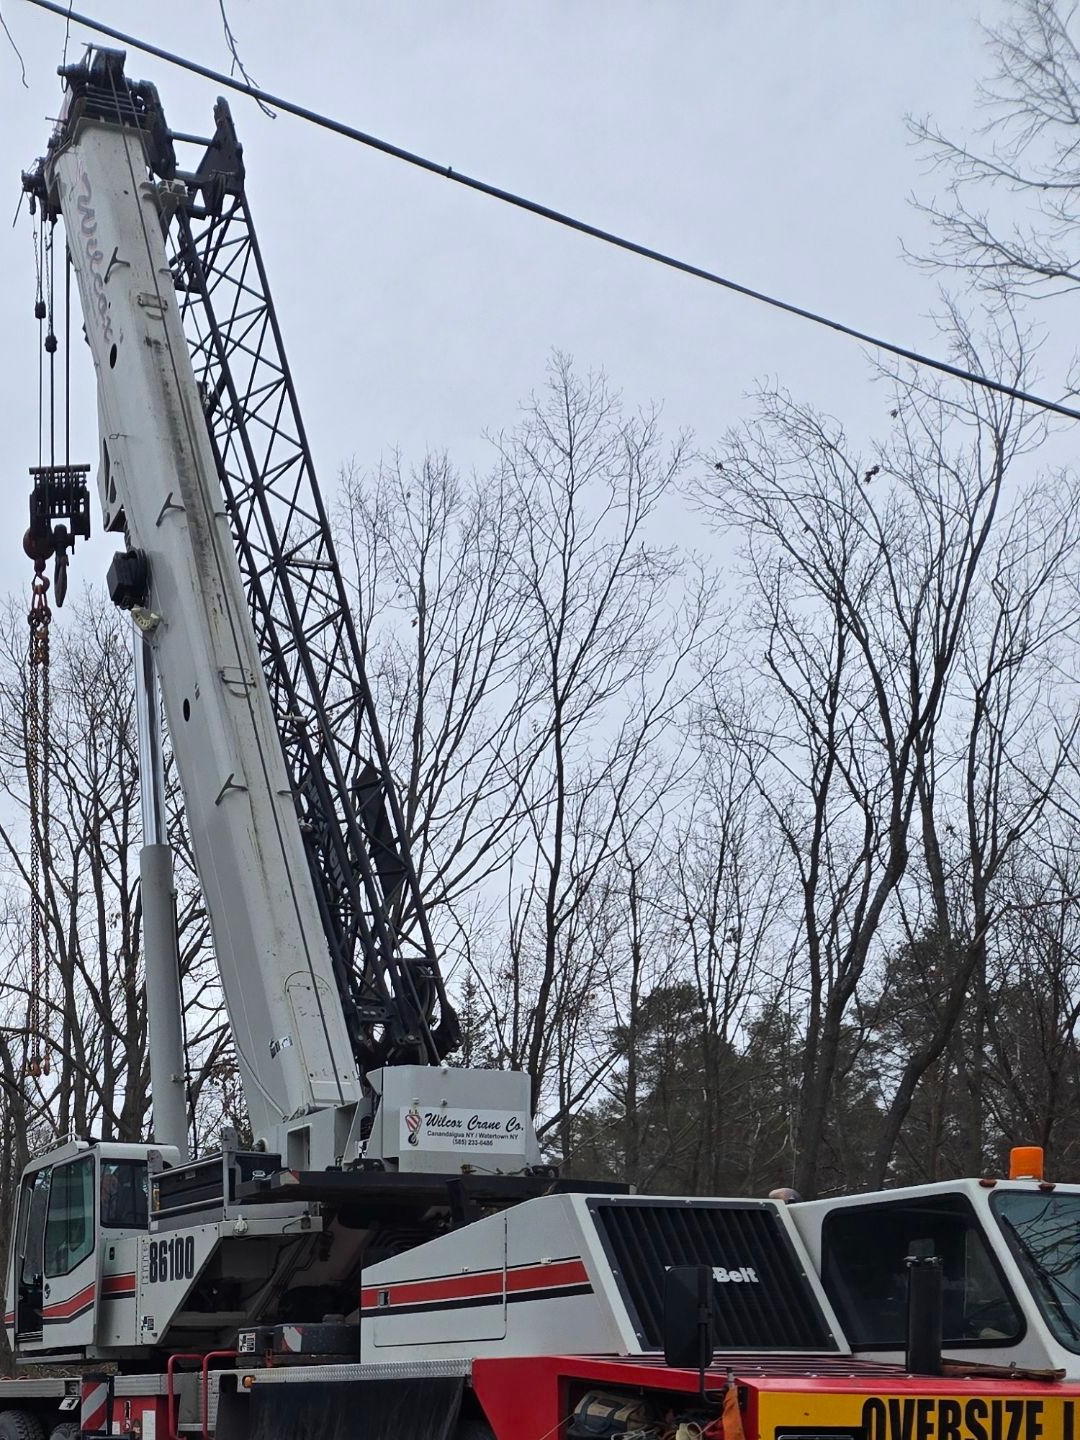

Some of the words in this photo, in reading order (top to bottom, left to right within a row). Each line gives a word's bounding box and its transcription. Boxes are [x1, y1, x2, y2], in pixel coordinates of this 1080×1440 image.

[424, 1113, 463, 1128] Wilcox
[467, 1115, 501, 1130] Crane
[505, 1116, 524, 1132] Co.
[427, 1130, 465, 1138] Canandaigua
[478, 1132, 509, 1140] Watertown
[149, 1235, 195, 1283] 86100
